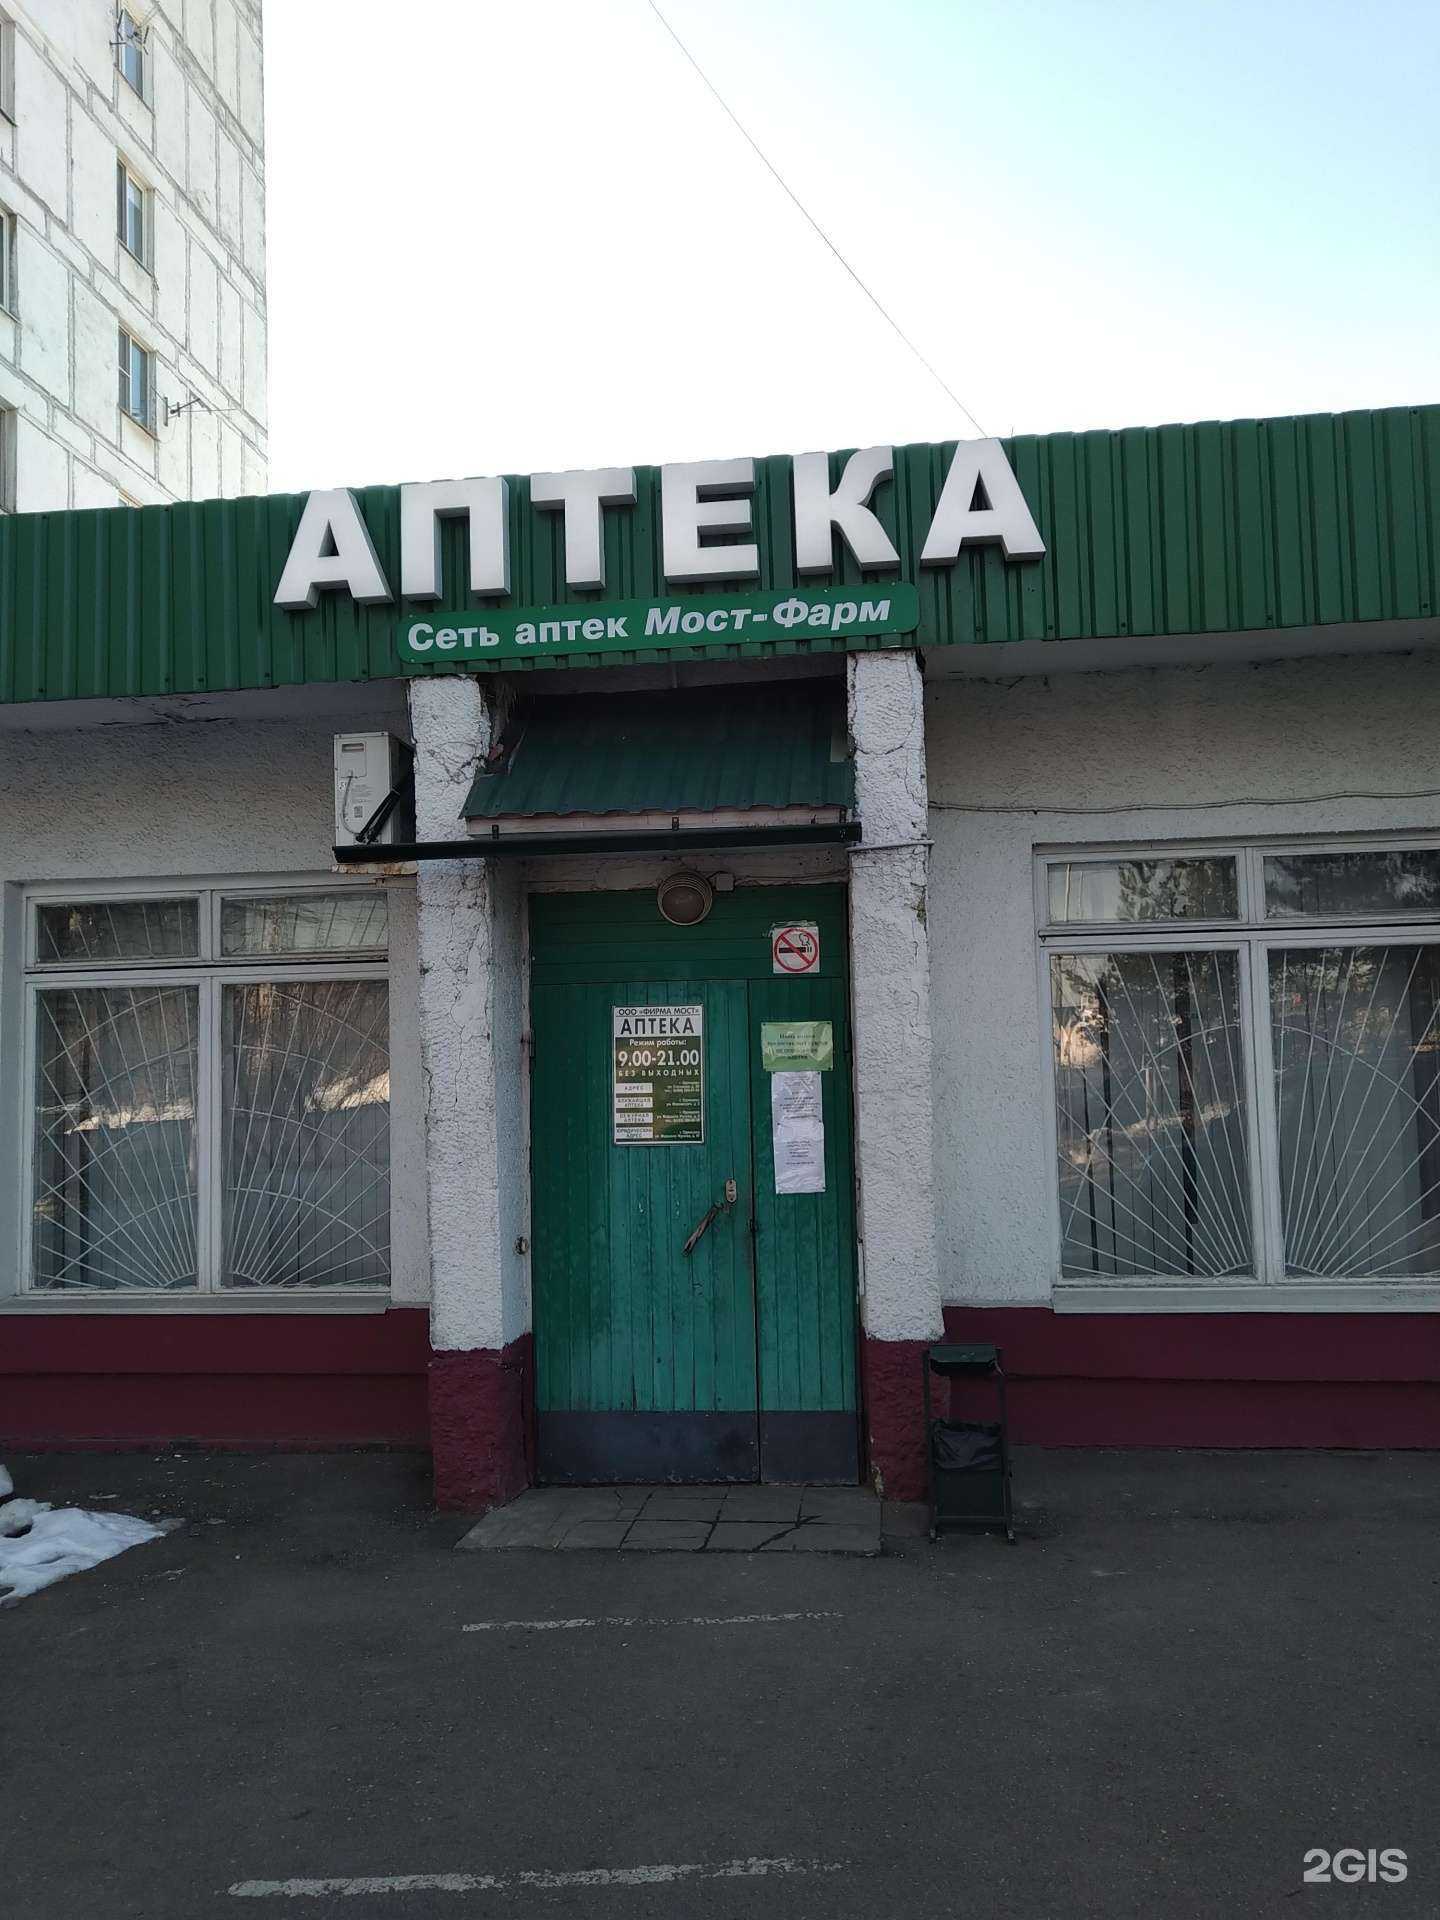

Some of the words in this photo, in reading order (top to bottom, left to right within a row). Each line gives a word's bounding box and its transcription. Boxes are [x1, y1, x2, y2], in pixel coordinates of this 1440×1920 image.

[273, 437, 1046, 612] АПТЕКА
[407, 621, 499, 651] Сеть
[514, 614, 629, 644] аптек
[644, 597, 891, 636] Мост-Фарм
[618, 1008, 637, 1016] ООО
[620, 1017, 695, 1035] АПТЕКА
[629, 1039, 655, 1047] Режим
[656, 1038, 687, 1048] работы:
[618, 1049, 699, 1067] 9.00-21.00
[618, 1069, 636, 1077] БЕЗ
[641, 1069, 699, 1077] ВЫХОДНЫХ
